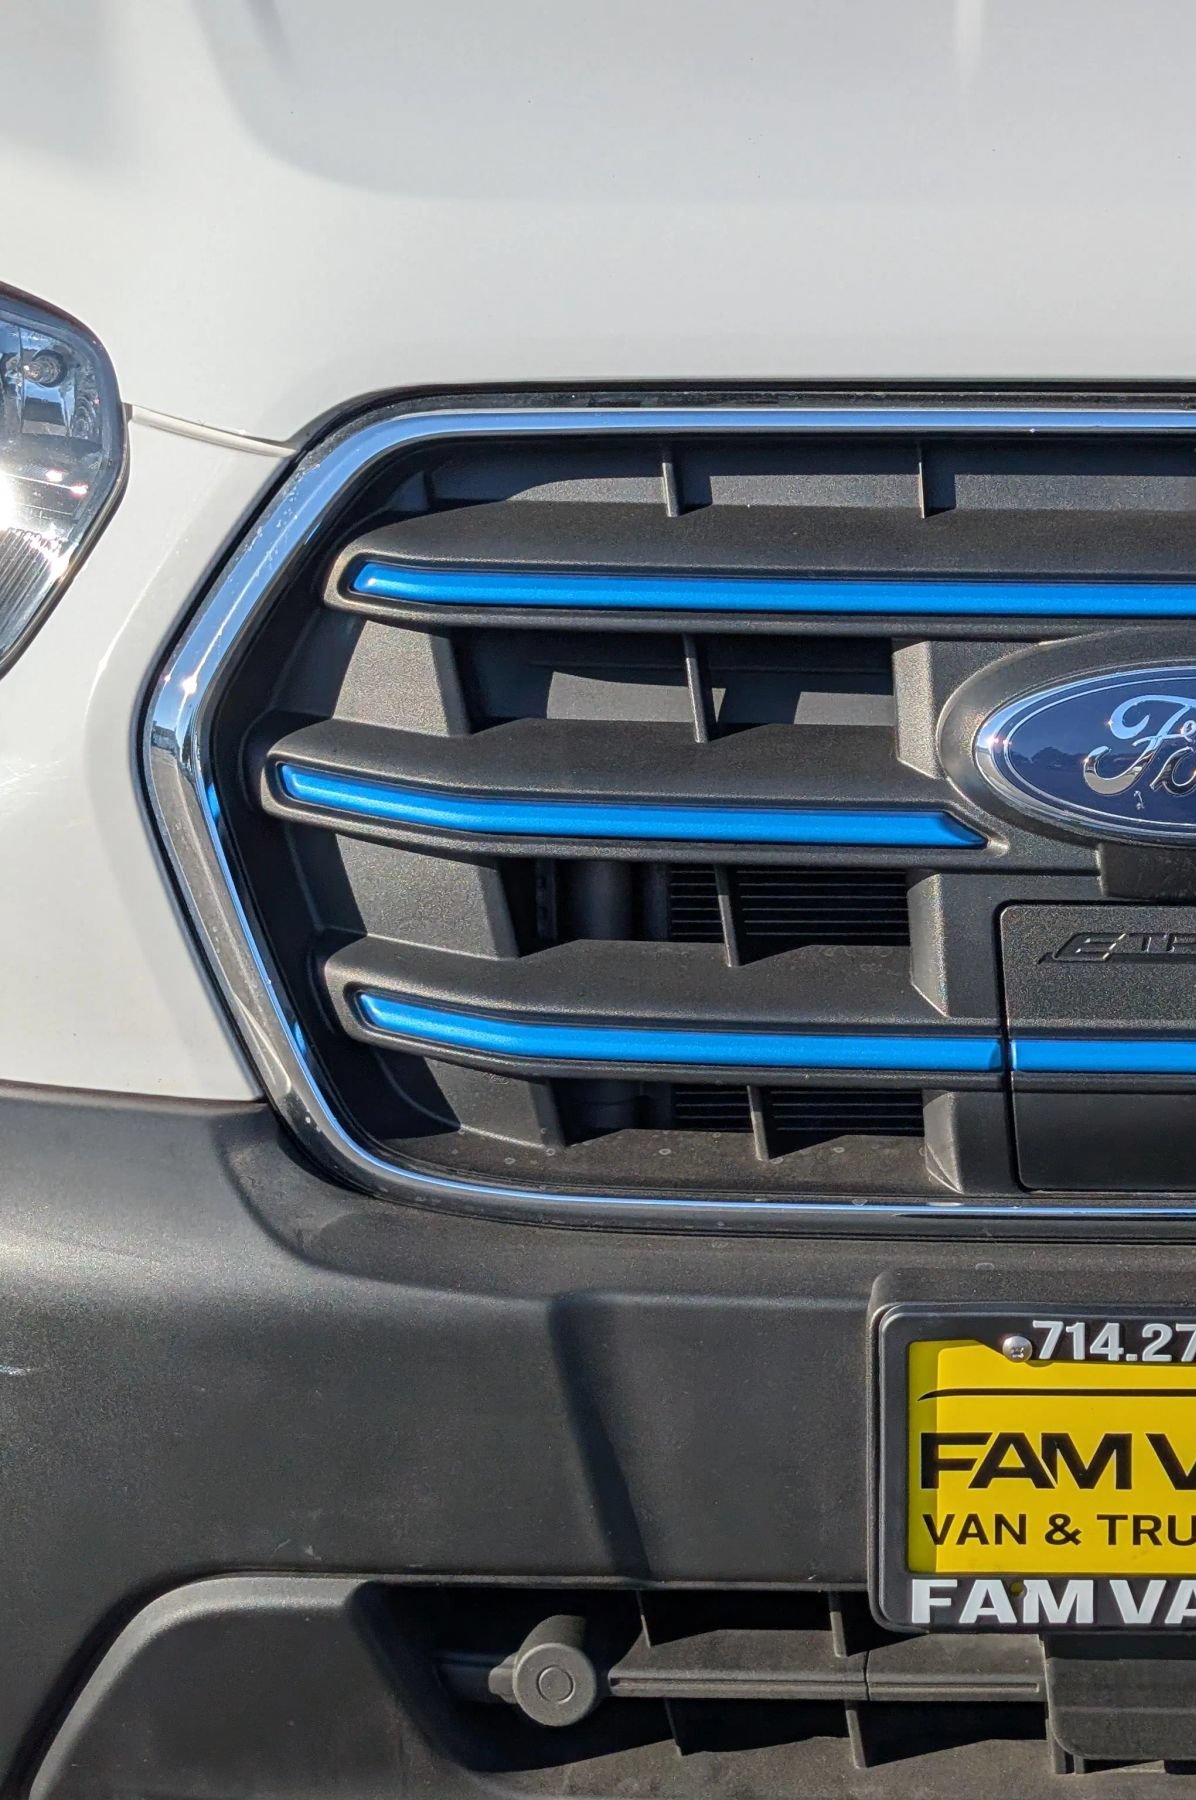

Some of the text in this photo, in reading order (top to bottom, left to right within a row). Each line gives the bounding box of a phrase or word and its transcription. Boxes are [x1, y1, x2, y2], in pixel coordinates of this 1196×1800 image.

[920, 1432, 1133, 1489] FAM
[923, 1514, 1027, 1546] VAN
[1044, 1514, 1082, 1546] &
[911, 1579, 1094, 1625] FAM
